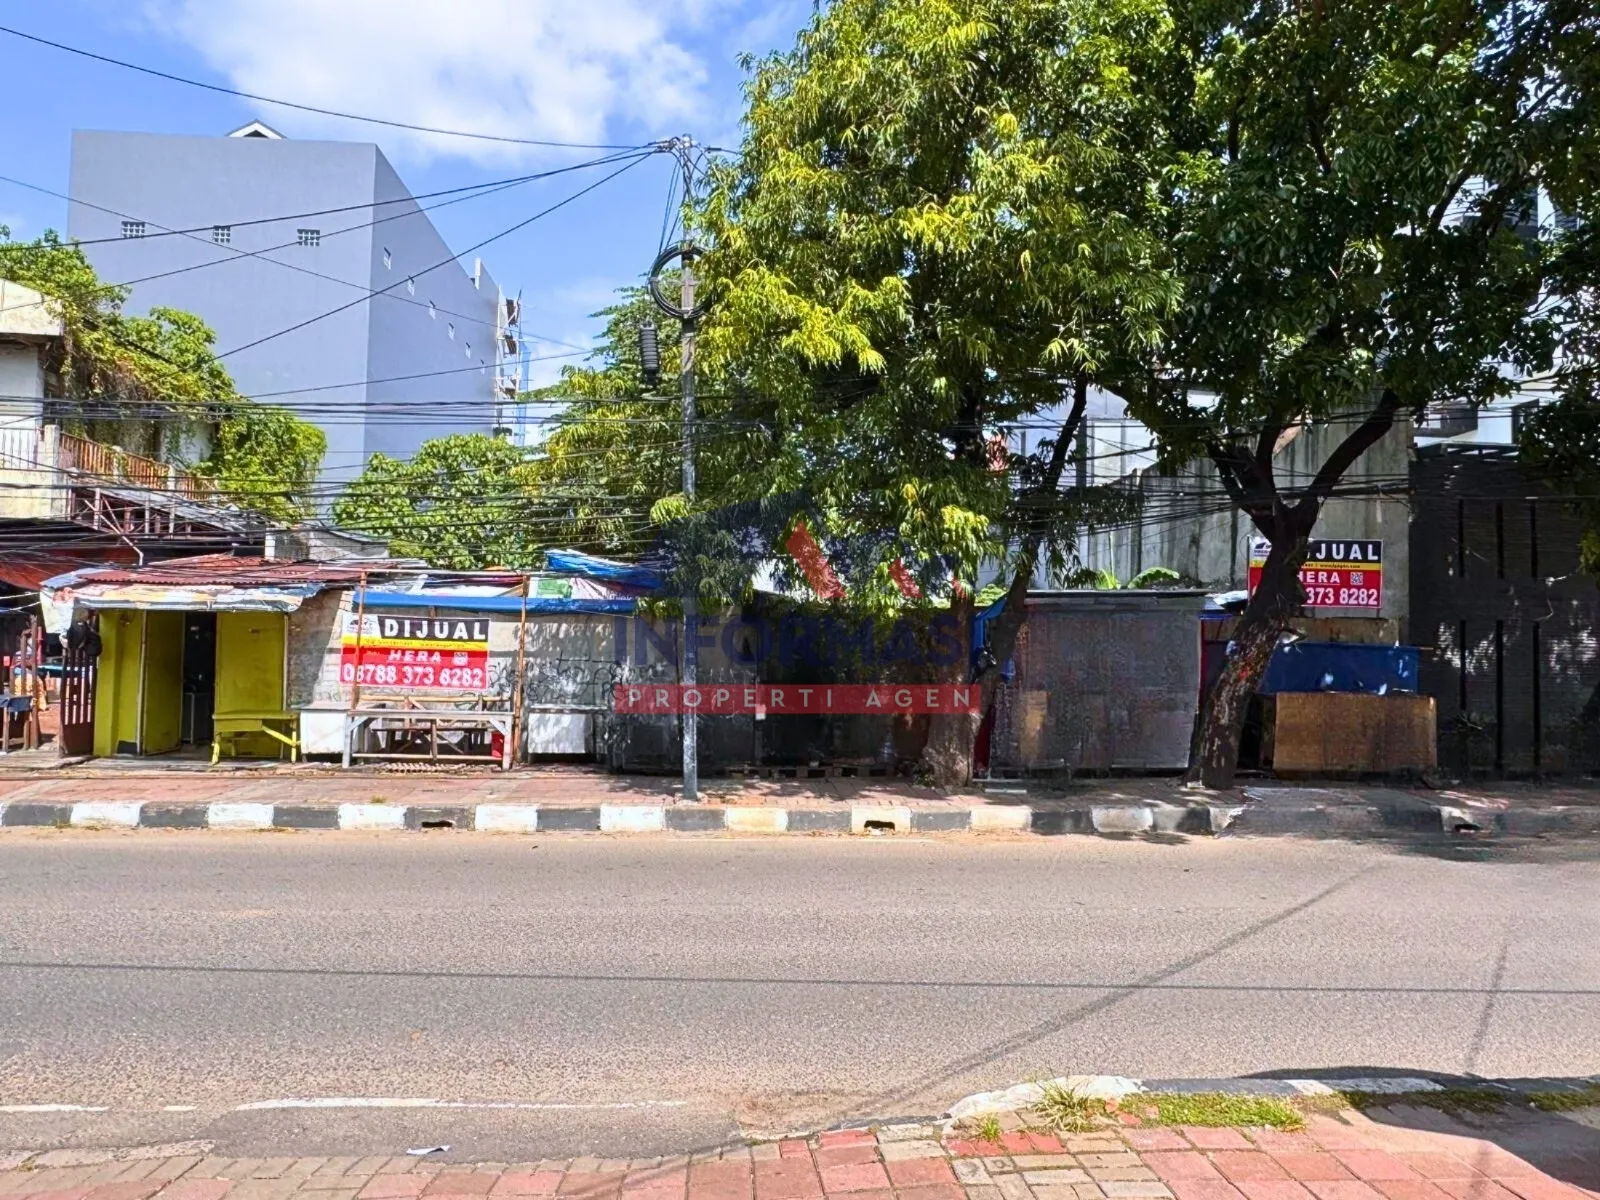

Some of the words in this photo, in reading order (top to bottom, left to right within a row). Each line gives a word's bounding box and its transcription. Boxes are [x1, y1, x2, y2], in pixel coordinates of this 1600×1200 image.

[1305, 587, 1335, 604] 373
[1339, 588, 1378, 605] 8282
[384, 618, 486, 640] DIJUAL
[388, 649, 442, 662] HERA
[402, 666, 434, 685] 373
[439, 668, 483, 687] 8282
